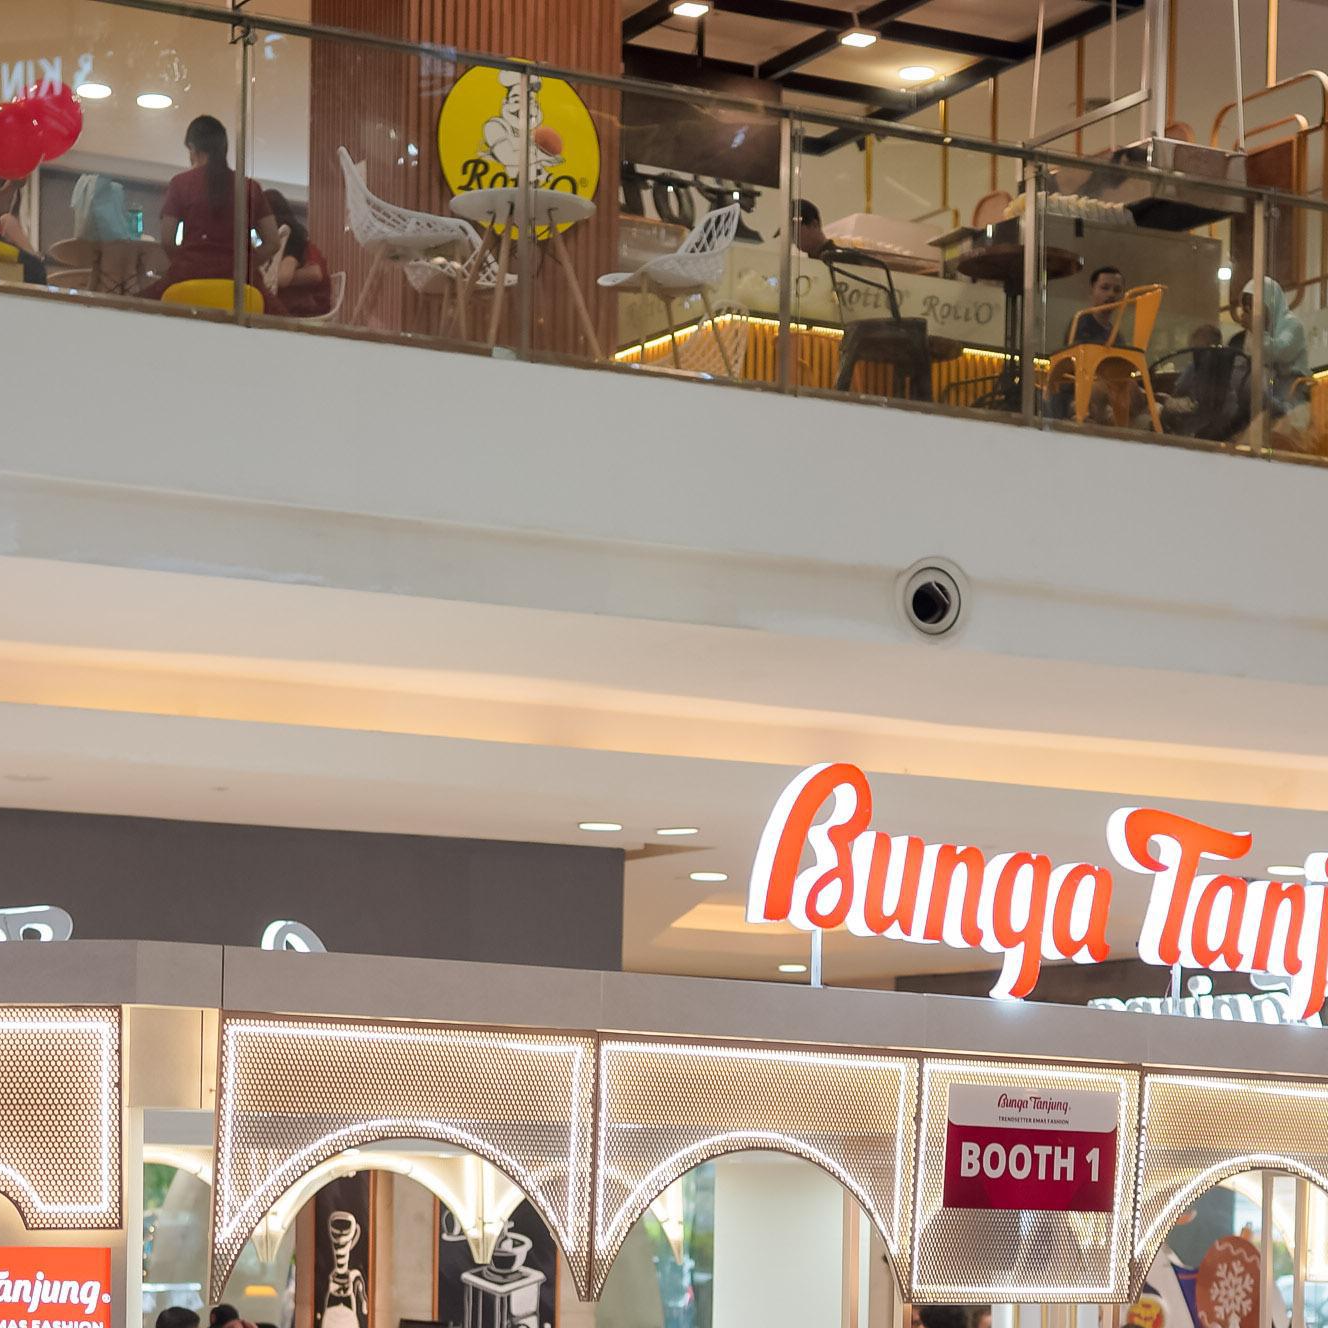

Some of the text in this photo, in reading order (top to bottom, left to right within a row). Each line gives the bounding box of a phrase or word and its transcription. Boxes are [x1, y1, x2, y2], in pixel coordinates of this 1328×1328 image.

[750, 762, 1113, 999] Bunga
[997, 1092, 1069, 1115] Bunga Tanjung
[960, 1141, 1100, 1182] BOOTH 1
